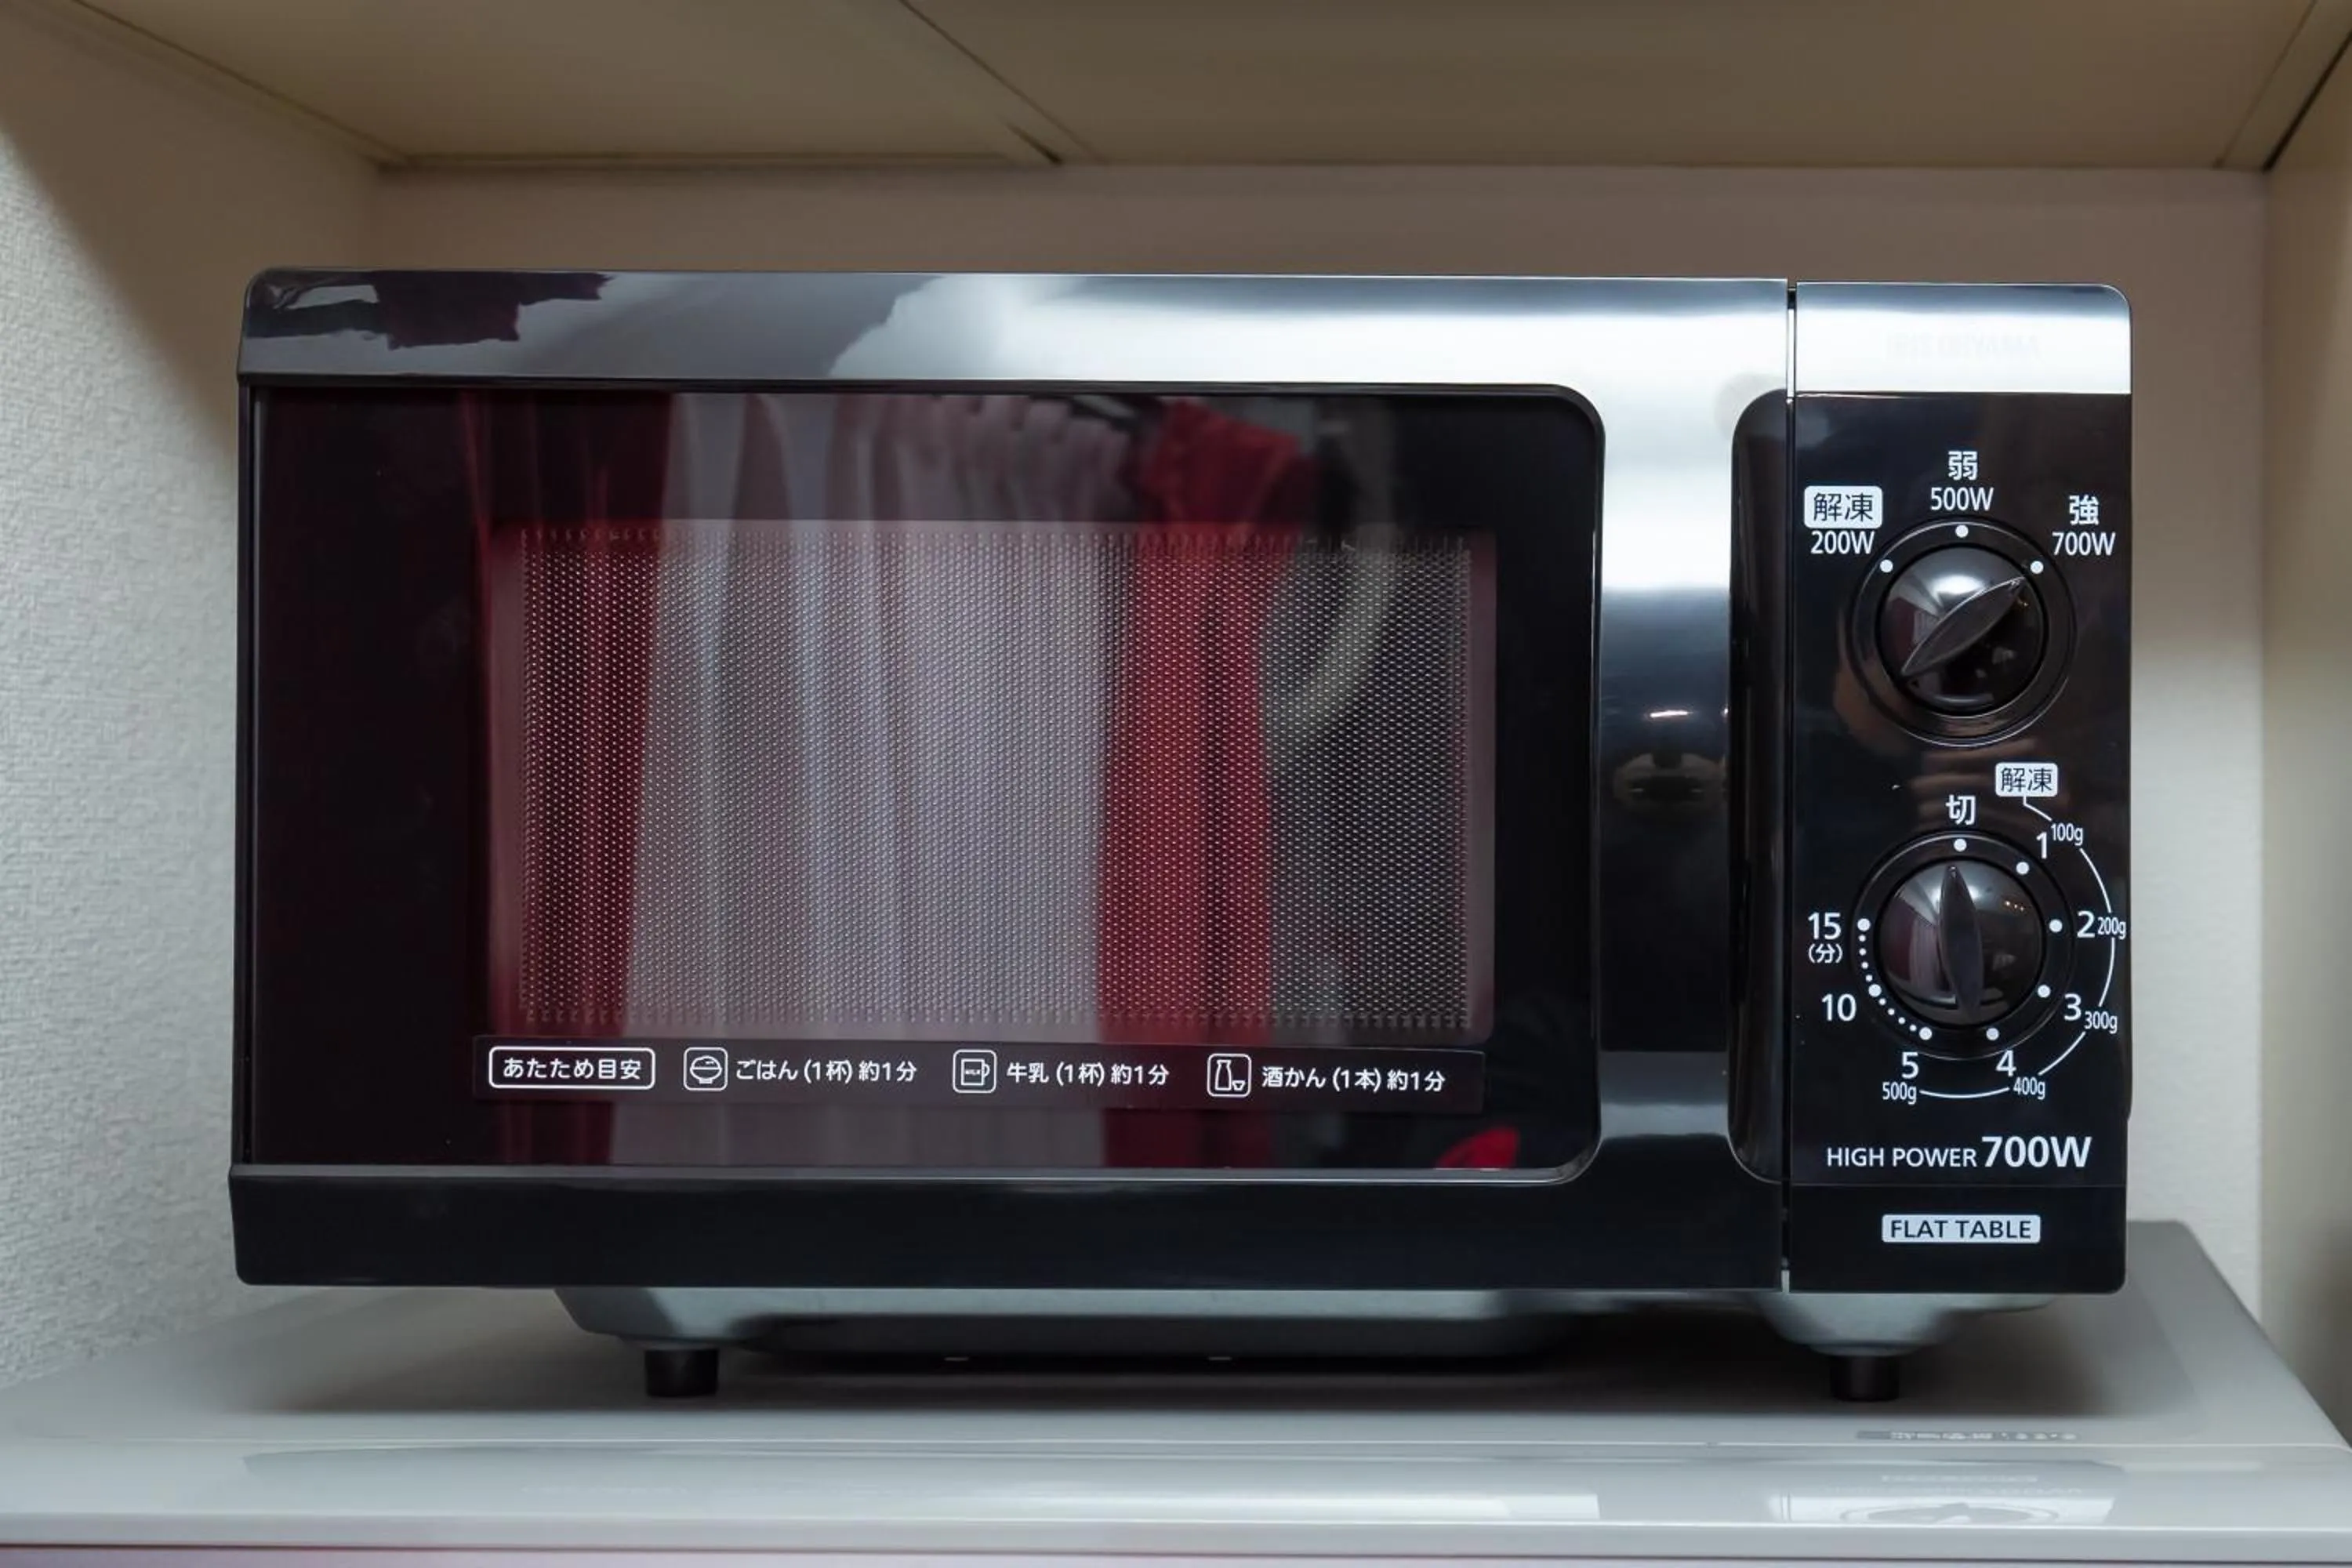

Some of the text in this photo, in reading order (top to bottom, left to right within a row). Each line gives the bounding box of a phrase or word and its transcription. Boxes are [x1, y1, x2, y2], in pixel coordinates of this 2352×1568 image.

[1948, 451, 1978, 481] 弱
[1813, 492, 1875, 522] 解凍
[1931, 487, 1994, 511] 500W
[2069, 495, 2100, 525] 強
[1811, 531, 1875, 554] 200W
[2052, 532, 2116, 556] 700W
[2000, 768, 2053, 793] 解凍
[1946, 794, 1976, 826] 切
[2037, 833, 2048, 859] 1
[2051, 823, 2084, 846] 100g
[1808, 913, 1842, 940] 15
[2077, 911, 2096, 938] 2
[2097, 916, 2126, 940] 200g
[1809, 943, 1842, 964] (分)
[1821, 993, 1857, 1022] 10
[2064, 993, 2082, 1021] 3
[2085, 1011, 2118, 1034] 300g
[503, 1058, 642, 1080] あたため目安
[1901, 1052, 1919, 1079] 5
[1996, 1051, 2016, 1076] 4
[1882, 1081, 1917, 1105] 500g
[2013, 1076, 2045, 1100] 400g
[1827, 1136, 2092, 1167] HIGH POWER 700W
[1890, 1220, 2032, 1240] FLAT TABLE
